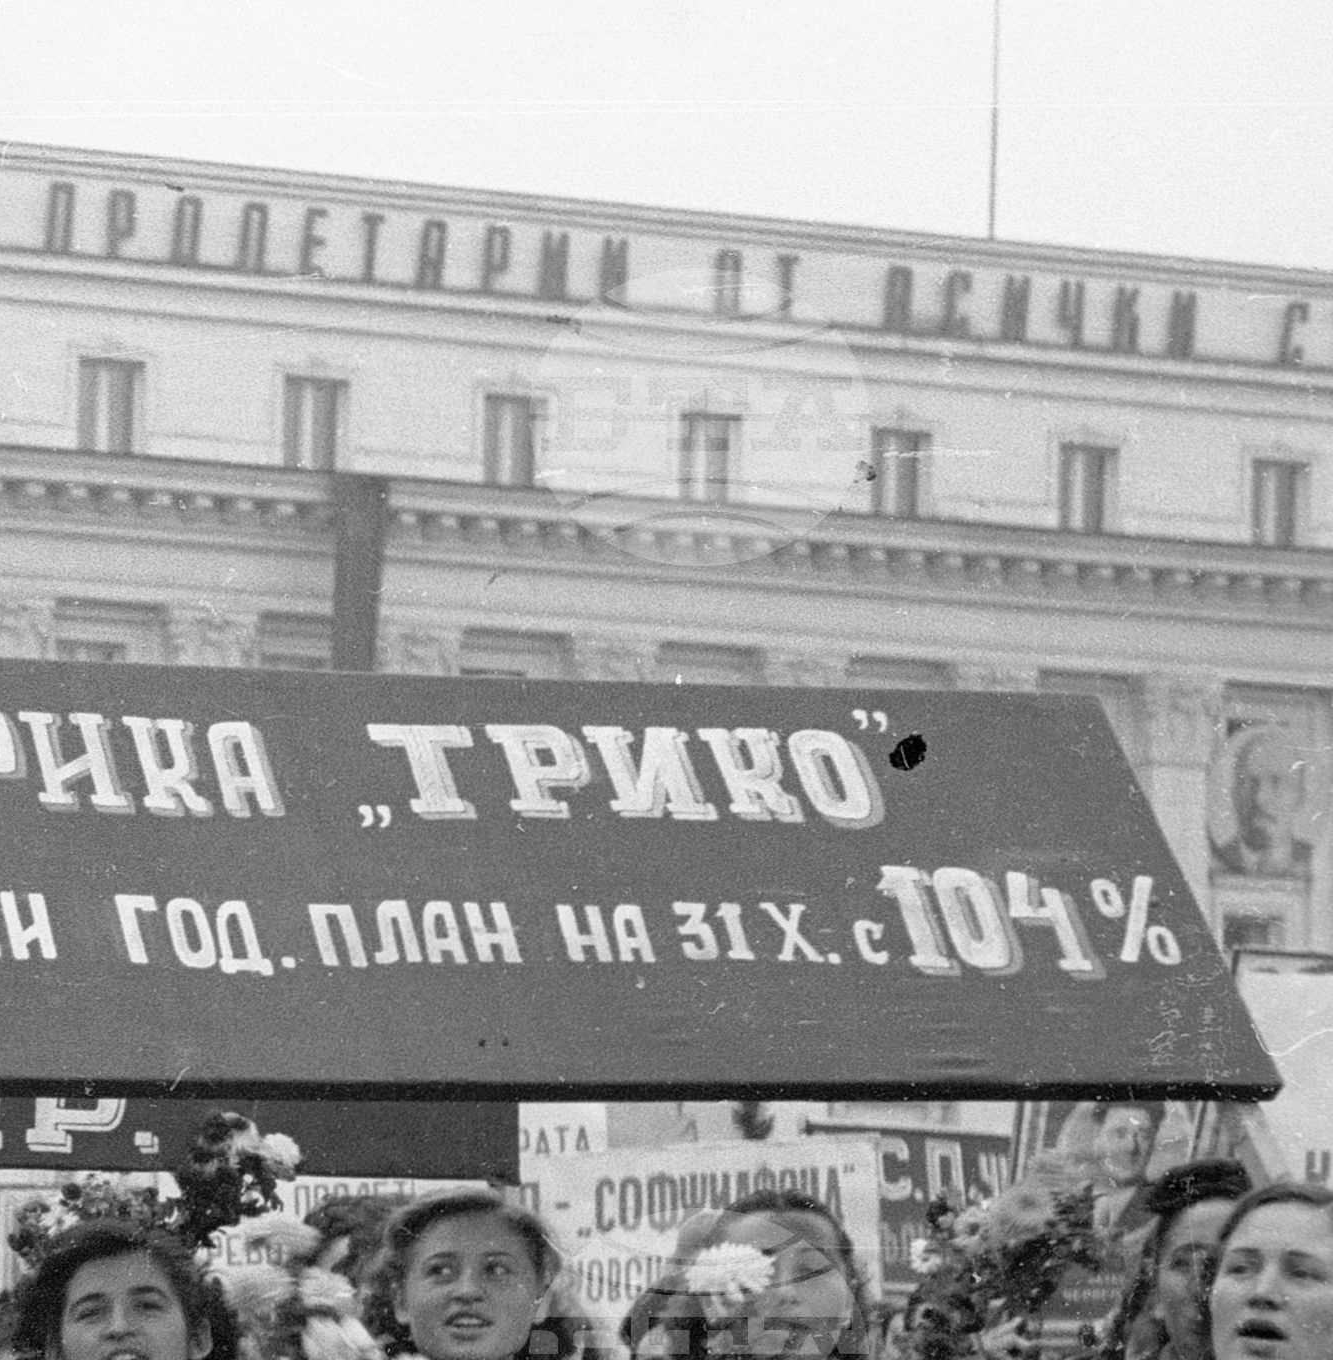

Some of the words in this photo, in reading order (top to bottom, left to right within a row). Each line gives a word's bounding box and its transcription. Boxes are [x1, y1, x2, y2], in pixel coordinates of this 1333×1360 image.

[43, 180, 630, 306] ПРОЛЕТАРИИ
[712, 248, 800, 319] ОТ
[881, 265, 1197, 359] ВСИЧКИ
[114, 893, 297, 976] ГОД.
[307, 899, 523, 968] ПЛАН
[556, 901, 656, 964] НА
